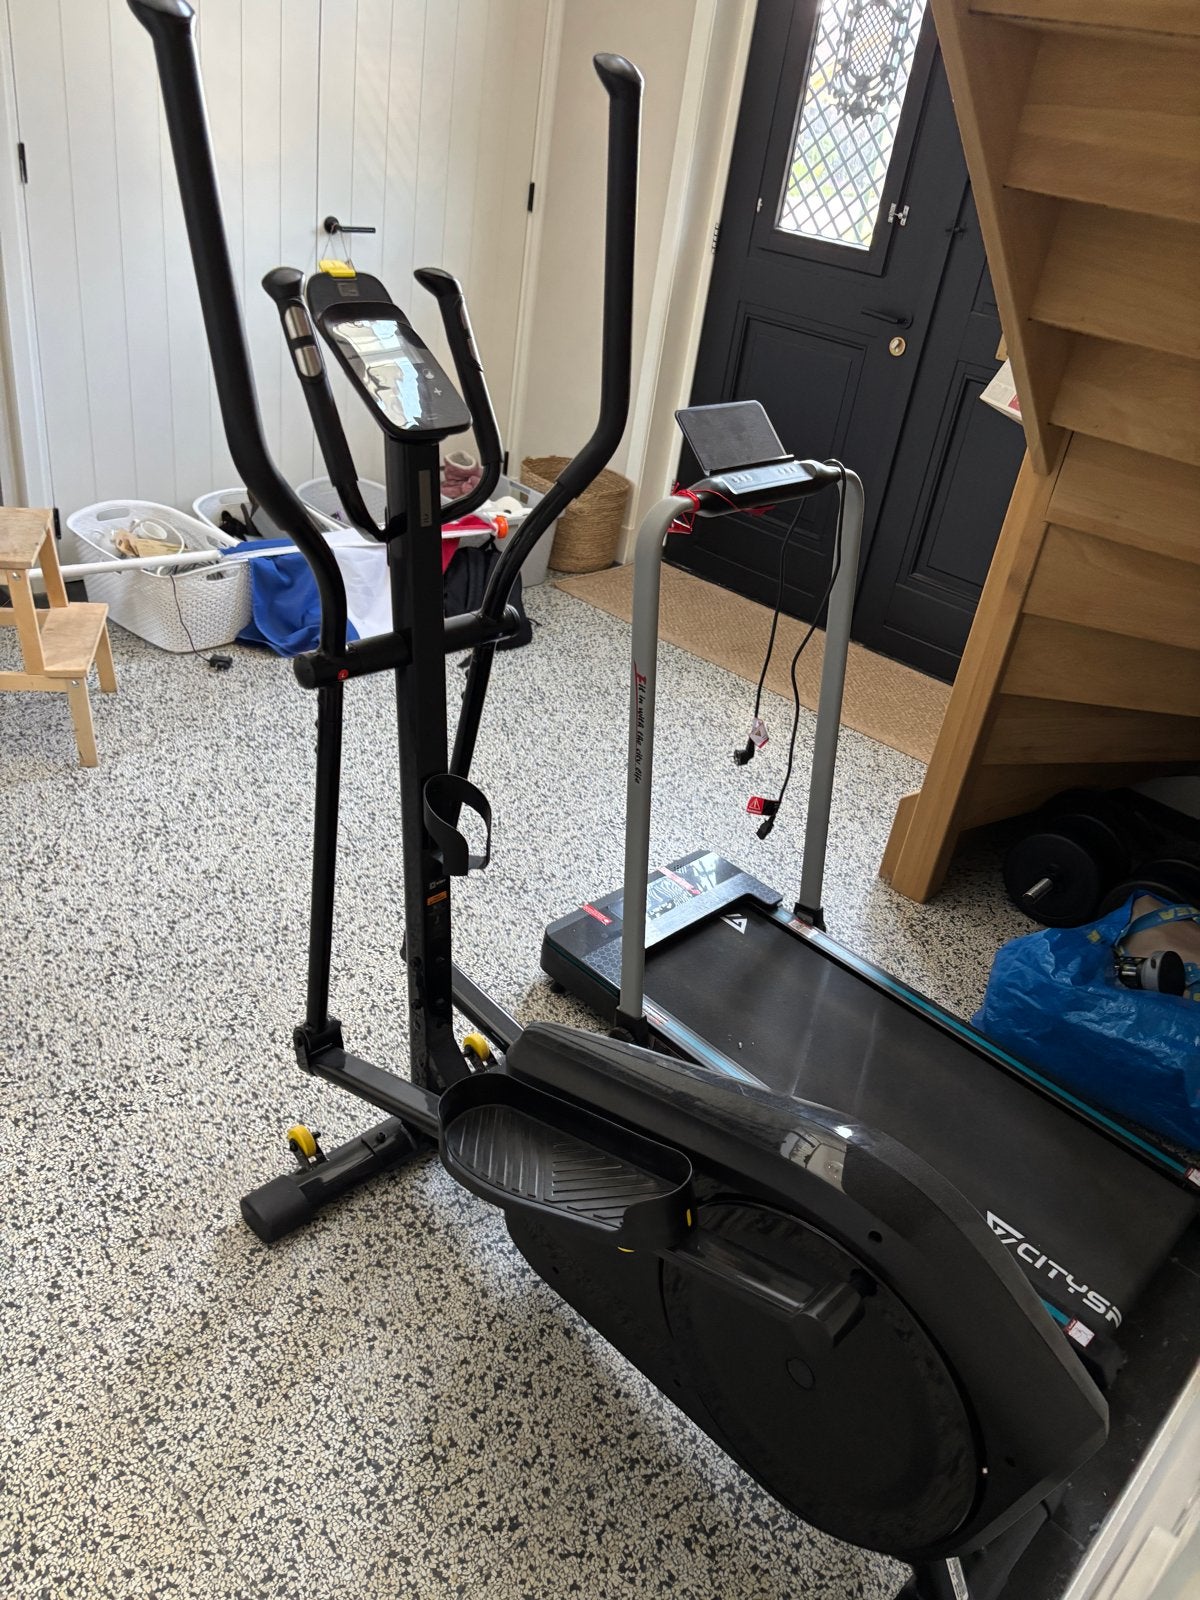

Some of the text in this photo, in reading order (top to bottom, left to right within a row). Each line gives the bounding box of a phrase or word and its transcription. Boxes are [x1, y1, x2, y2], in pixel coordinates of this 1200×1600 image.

[638, 694, 646, 705] in
[637, 706, 645, 729] with
[635, 730, 645, 746] the
[635, 747, 644, 766] city
[634, 767, 642, 784] life
